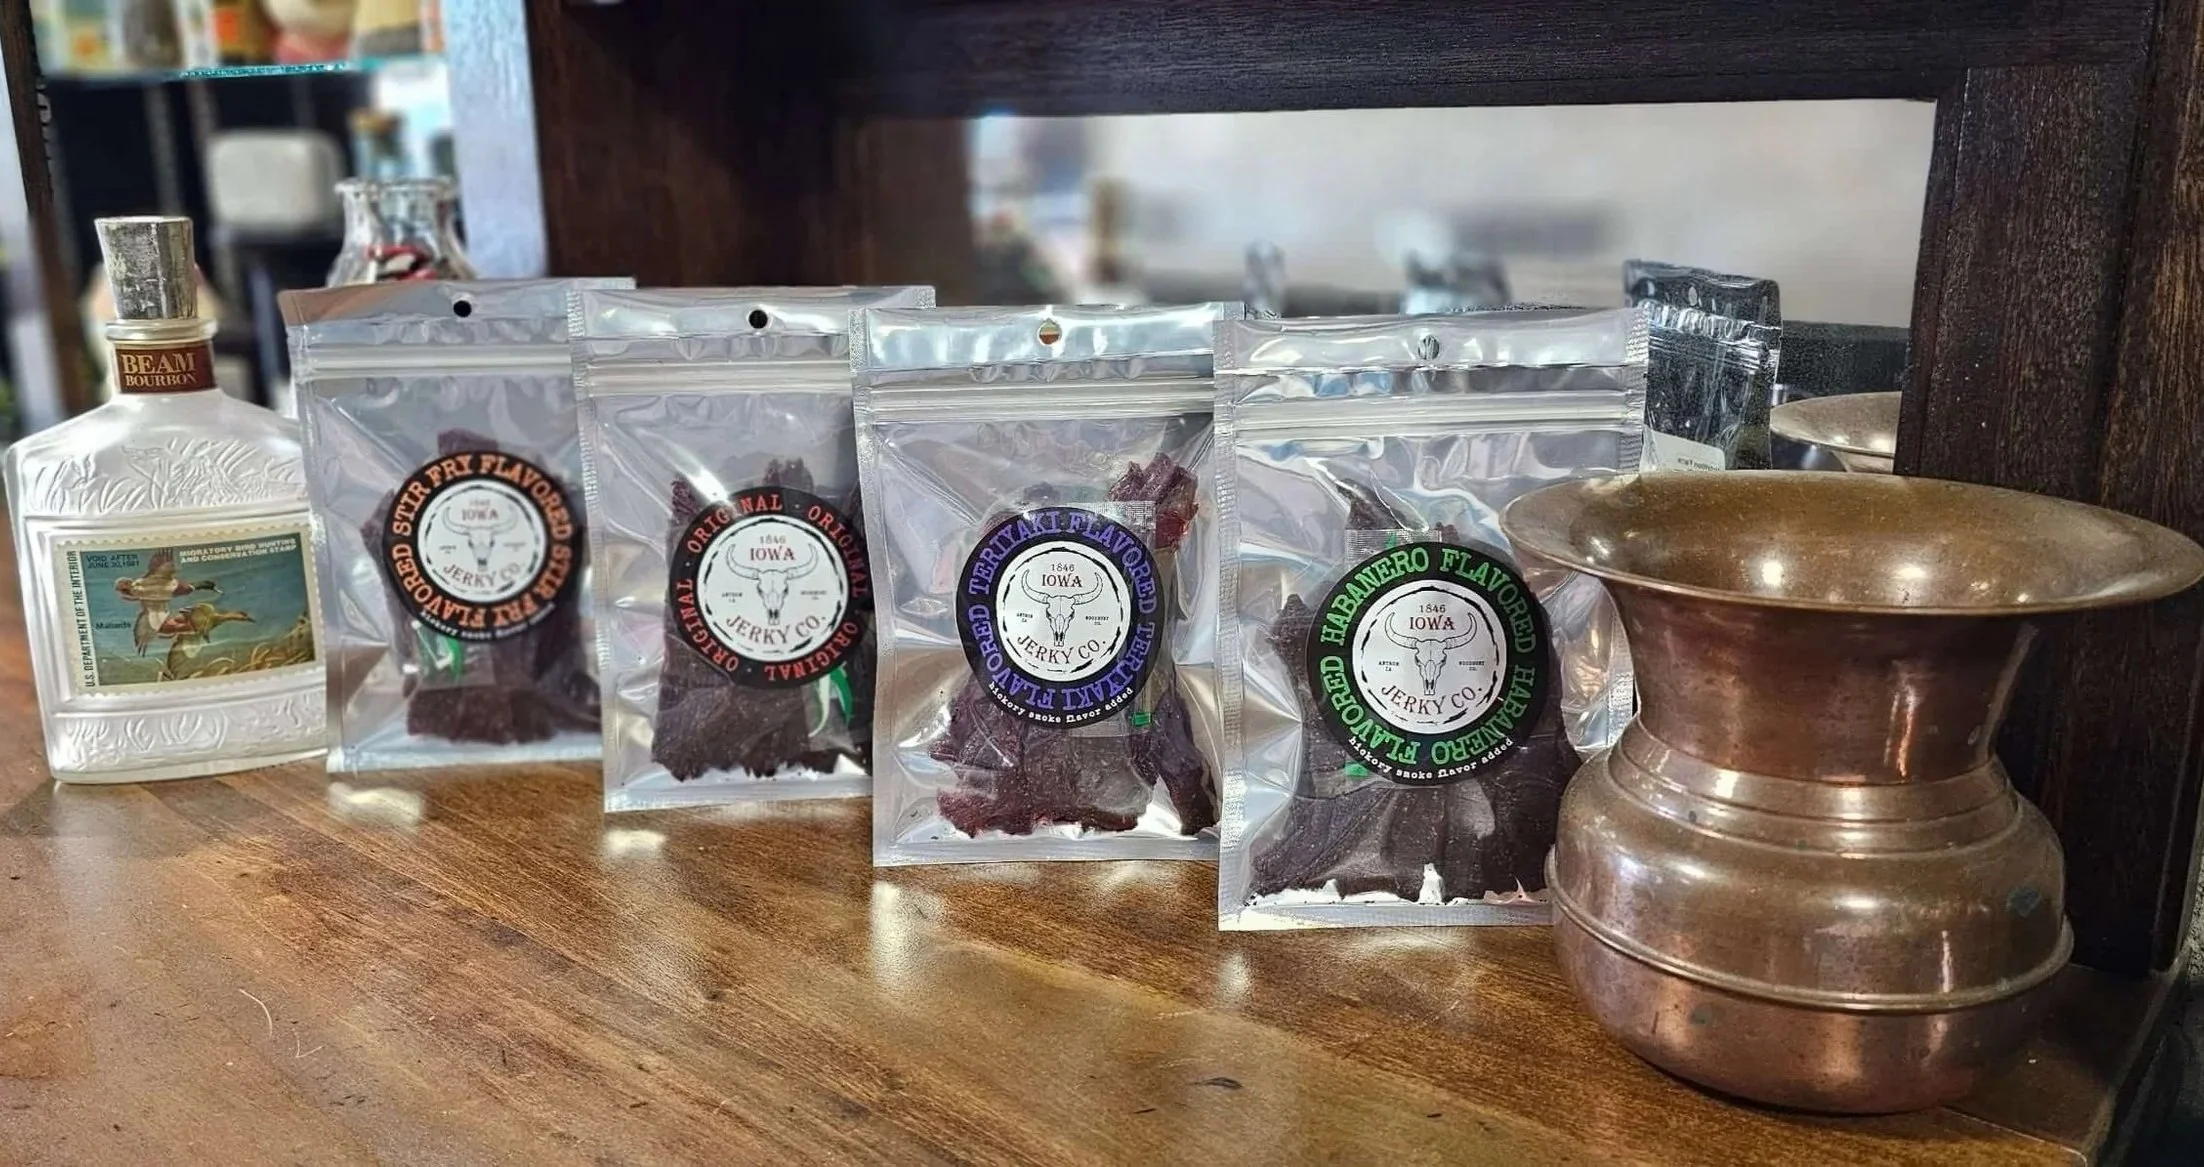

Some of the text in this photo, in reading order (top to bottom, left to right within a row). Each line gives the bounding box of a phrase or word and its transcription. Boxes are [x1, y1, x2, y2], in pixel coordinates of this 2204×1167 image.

[121, 352, 196, 374] BEAM
[125, 373, 197, 388] BOURBON
[393, 454, 573, 541] STIR FRY FLAVORED
[462, 508, 499, 521] IOWA
[750, 545, 796, 561] IOWA
[969, 511, 1156, 614] TERIYAKI FLAVORED
[1051, 563, 1075, 572] 1846
[392, 543, 487, 628] FLAVORED
[443, 564, 497, 586] JERKY
[678, 494, 868, 681] ORIGINAL ORIGINAL ORIGINAL ORIGINAL
[1041, 573, 1083, 588] IOWA
[73, 590, 84, 606] THE
[75, 606, 86, 617] OF
[493, 593, 539, 627] FRY
[1320, 546, 1537, 654] HABANERO FLAVORED
[1420, 604, 1446, 613] 1846
[726, 615, 826, 645] JERKY CO.
[1409, 614, 1455, 631] IOWA
[76, 617, 94, 672] DEPARTMENT
[968, 604, 1155, 711] TERIYAKI FLAVORED
[1017, 635, 1106, 664] JERKY CO.
[988, 681, 1134, 723] hickory smoke flavor added
[1319, 655, 1536, 766] HABANERO FLAVORED
[1381, 685, 1482, 715] JERKY CO.
[1348, 735, 1514, 779] hickory smoke flavor added
